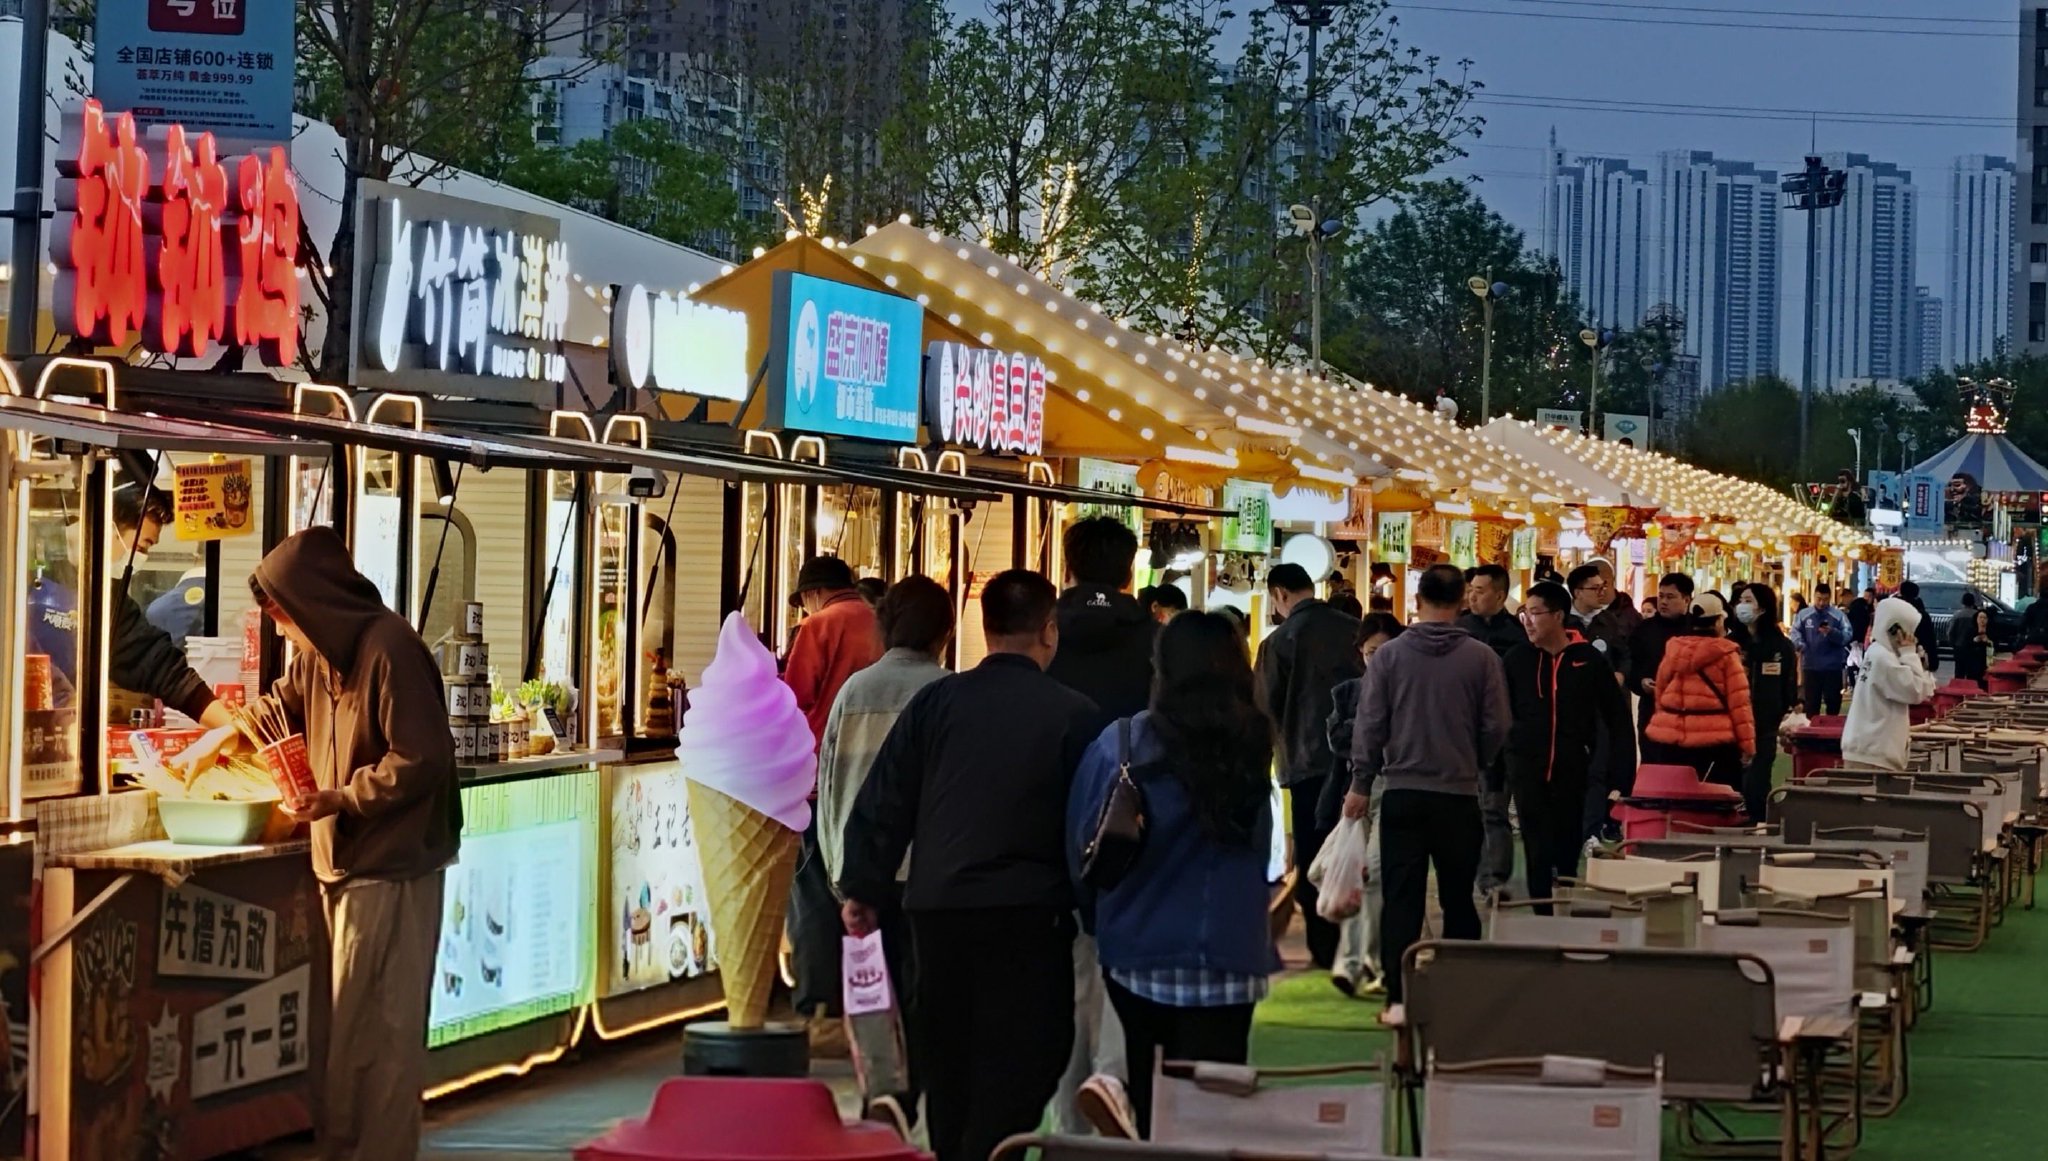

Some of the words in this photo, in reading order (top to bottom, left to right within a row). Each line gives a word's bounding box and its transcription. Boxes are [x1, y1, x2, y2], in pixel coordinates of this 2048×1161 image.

[117, 46, 274, 71] 全国店铺600+连锁
[189, 70, 253, 85] 黄金999.99
[955, 343, 1045, 457] 长沙臭豆腐
[165, 892, 268, 973] 先撸为敬
